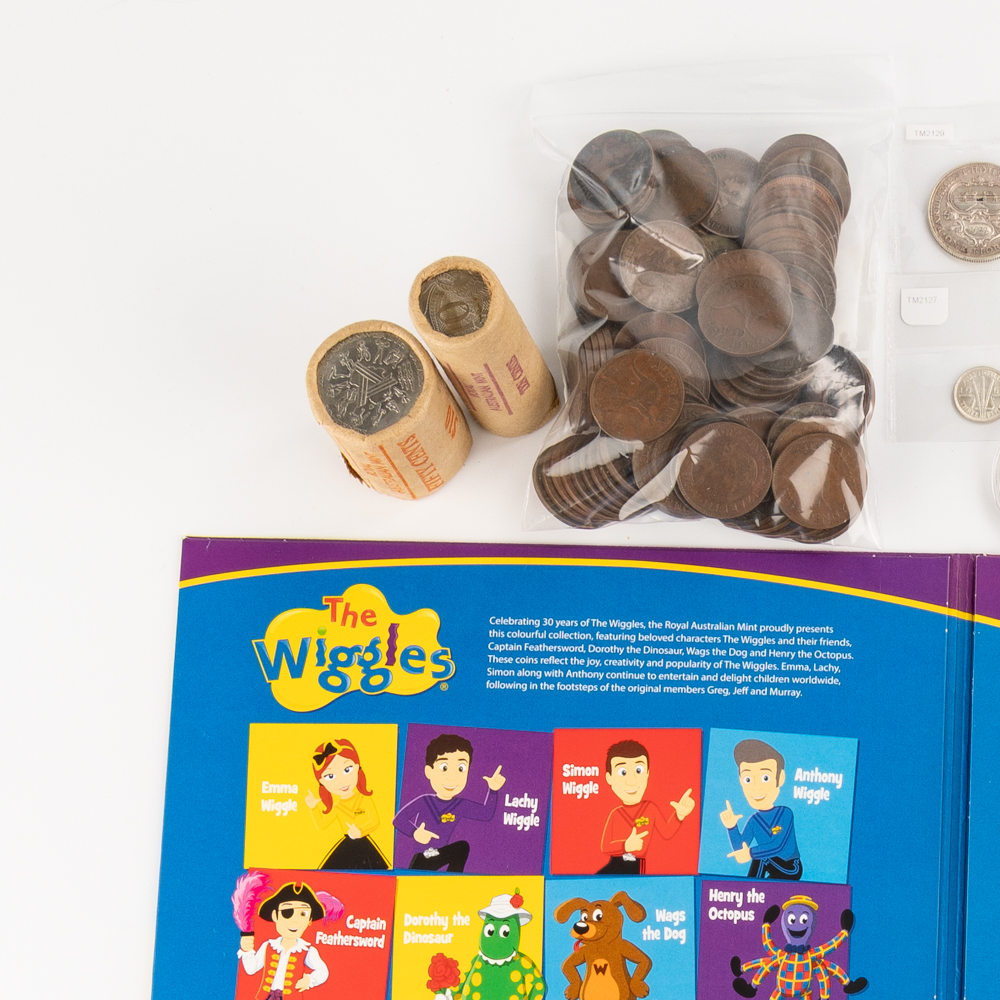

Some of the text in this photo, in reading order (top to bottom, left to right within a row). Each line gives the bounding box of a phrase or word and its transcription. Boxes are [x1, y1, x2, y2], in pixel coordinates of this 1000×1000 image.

[914, 129, 945, 137] TM2129
[907, 296, 938, 304] TM2127
[397, 433, 445, 493] FIFTY CENTS
[324, 597, 377, 628] The
[488, 616, 834, 635] Celebrating 30 years of The Wiggles, the Royal Australian Mint proudly presents
[254, 623, 454, 694] Wiggles
[562, 762, 600, 779] Simon
[794, 767, 843, 789] Anthony
[261, 781, 298, 794] Emma
[562, 779, 600, 798] Wiggle
[793, 785, 830, 805] Wiggle
[261, 799, 298, 816] Wiggle
[504, 794, 539, 814] Lachy
[503, 811, 541, 831] Wiggle
[708, 888, 765, 908] Henry the
[346, 915, 387, 933] Captain
[404, 912, 471, 929] Dorothy the
[655, 908, 686, 926] Wags
[708, 906, 755, 924] Octopus
[315, 930, 385, 949] Feathersword
[403, 930, 454, 945] Dinosaur
[642, 925, 687, 945] the Dog
